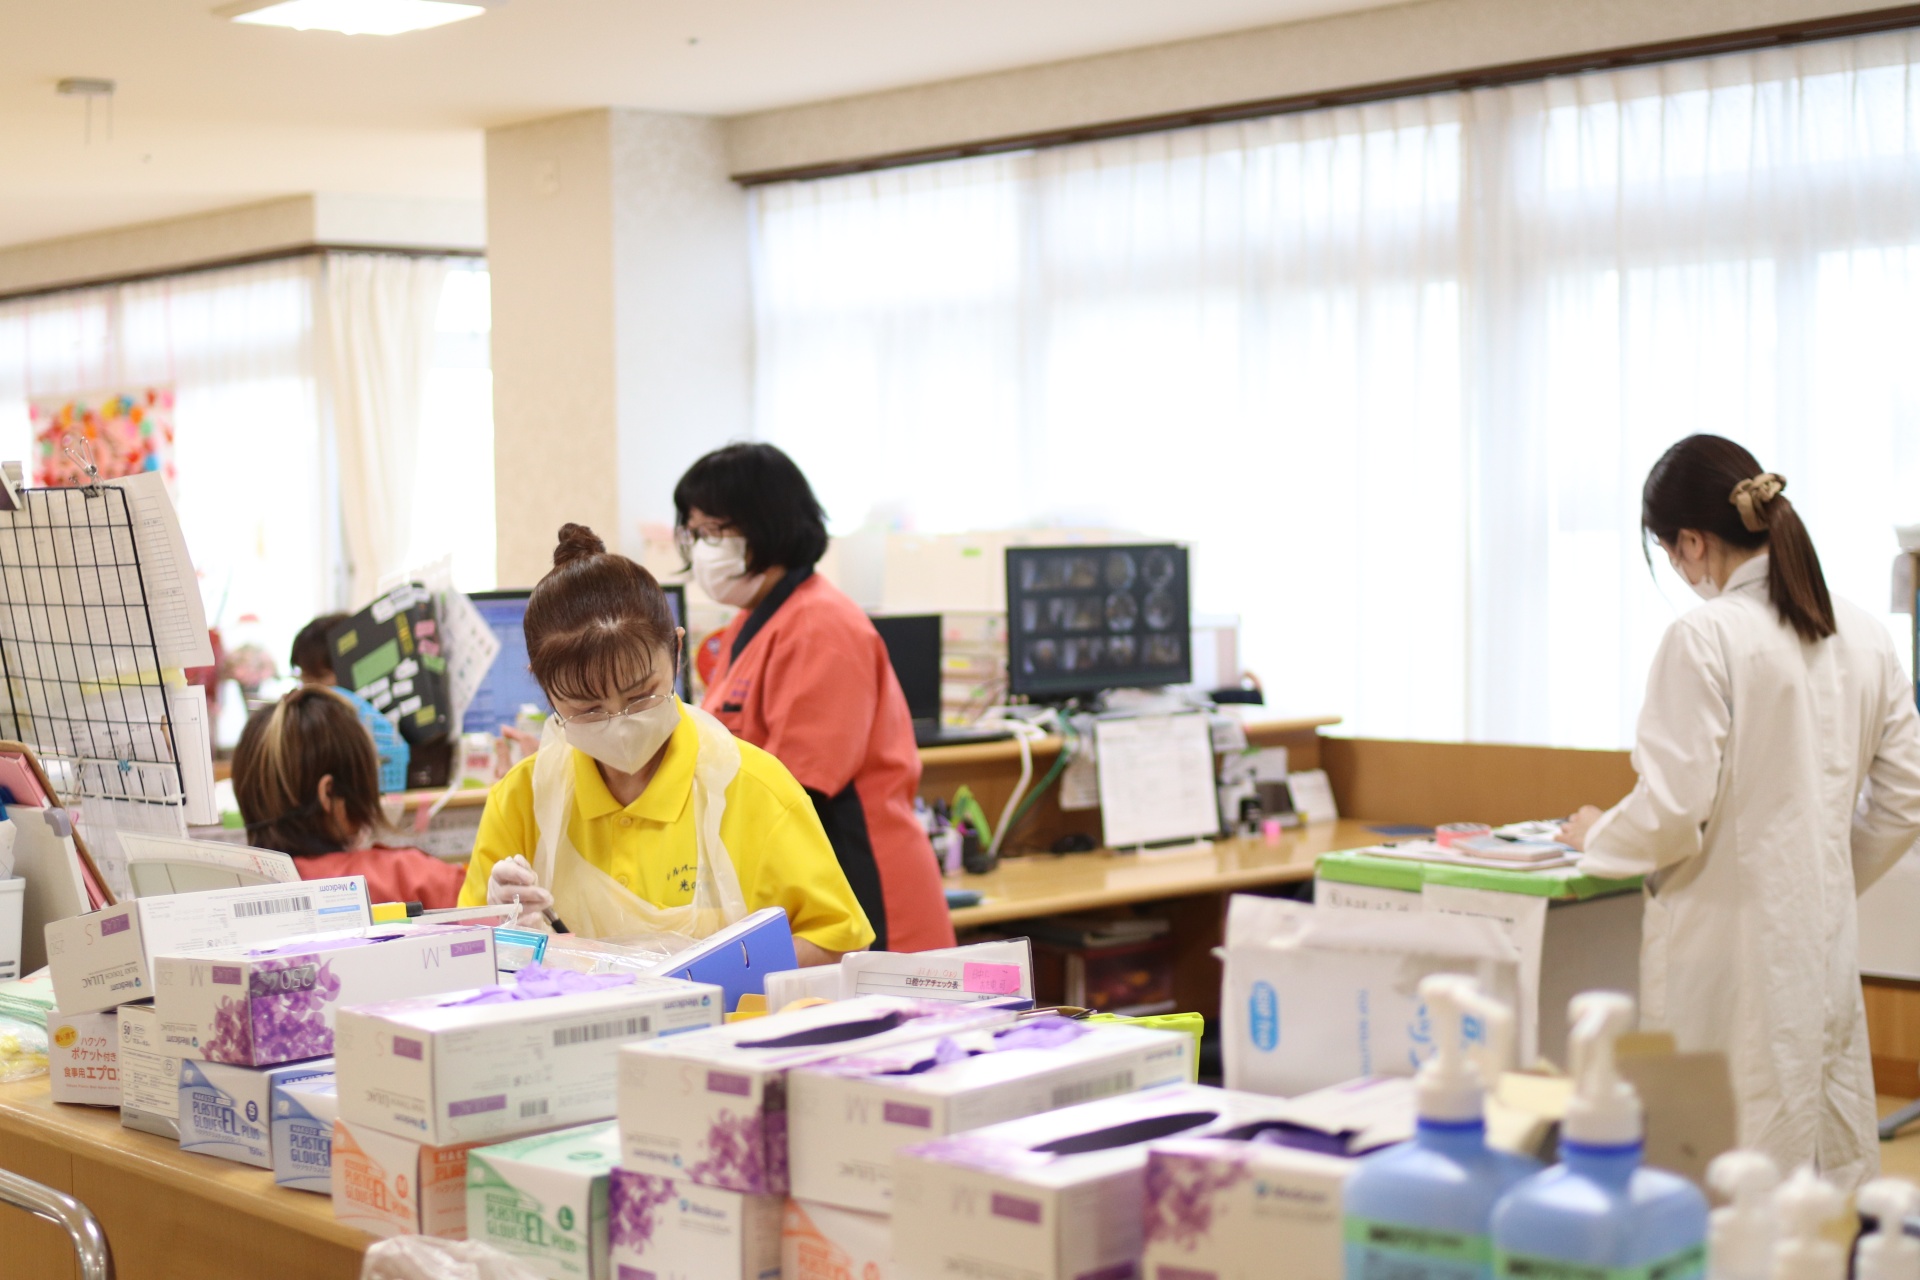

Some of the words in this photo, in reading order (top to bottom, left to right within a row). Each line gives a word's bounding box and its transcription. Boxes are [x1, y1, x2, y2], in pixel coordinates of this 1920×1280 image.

[319, 883, 348, 893] Medicom
[84, 923, 94, 946] S
[421, 945, 440, 970] M
[82, 973, 106, 990] LILAC
[189, 964, 204, 987] M
[280, 967, 313, 990] 250
[905, 977, 959, 990] 口腔ケアチェック表
[110, 979, 134, 992] Medicom
[80, 1037, 107, 1048] ハクゾウ
[71, 1047, 117, 1062] ポケット付き
[192, 1101, 223, 1118] PLASTIC
[193, 1114, 224, 1132] GLOVES
[222, 1107, 240, 1136] EL
[241, 1125, 260, 1140] PLUS
[290, 1134, 327, 1152] PLASTIC
[290, 1148, 328, 1166] GLOVES
[525, 1211, 551, 1247] EL
